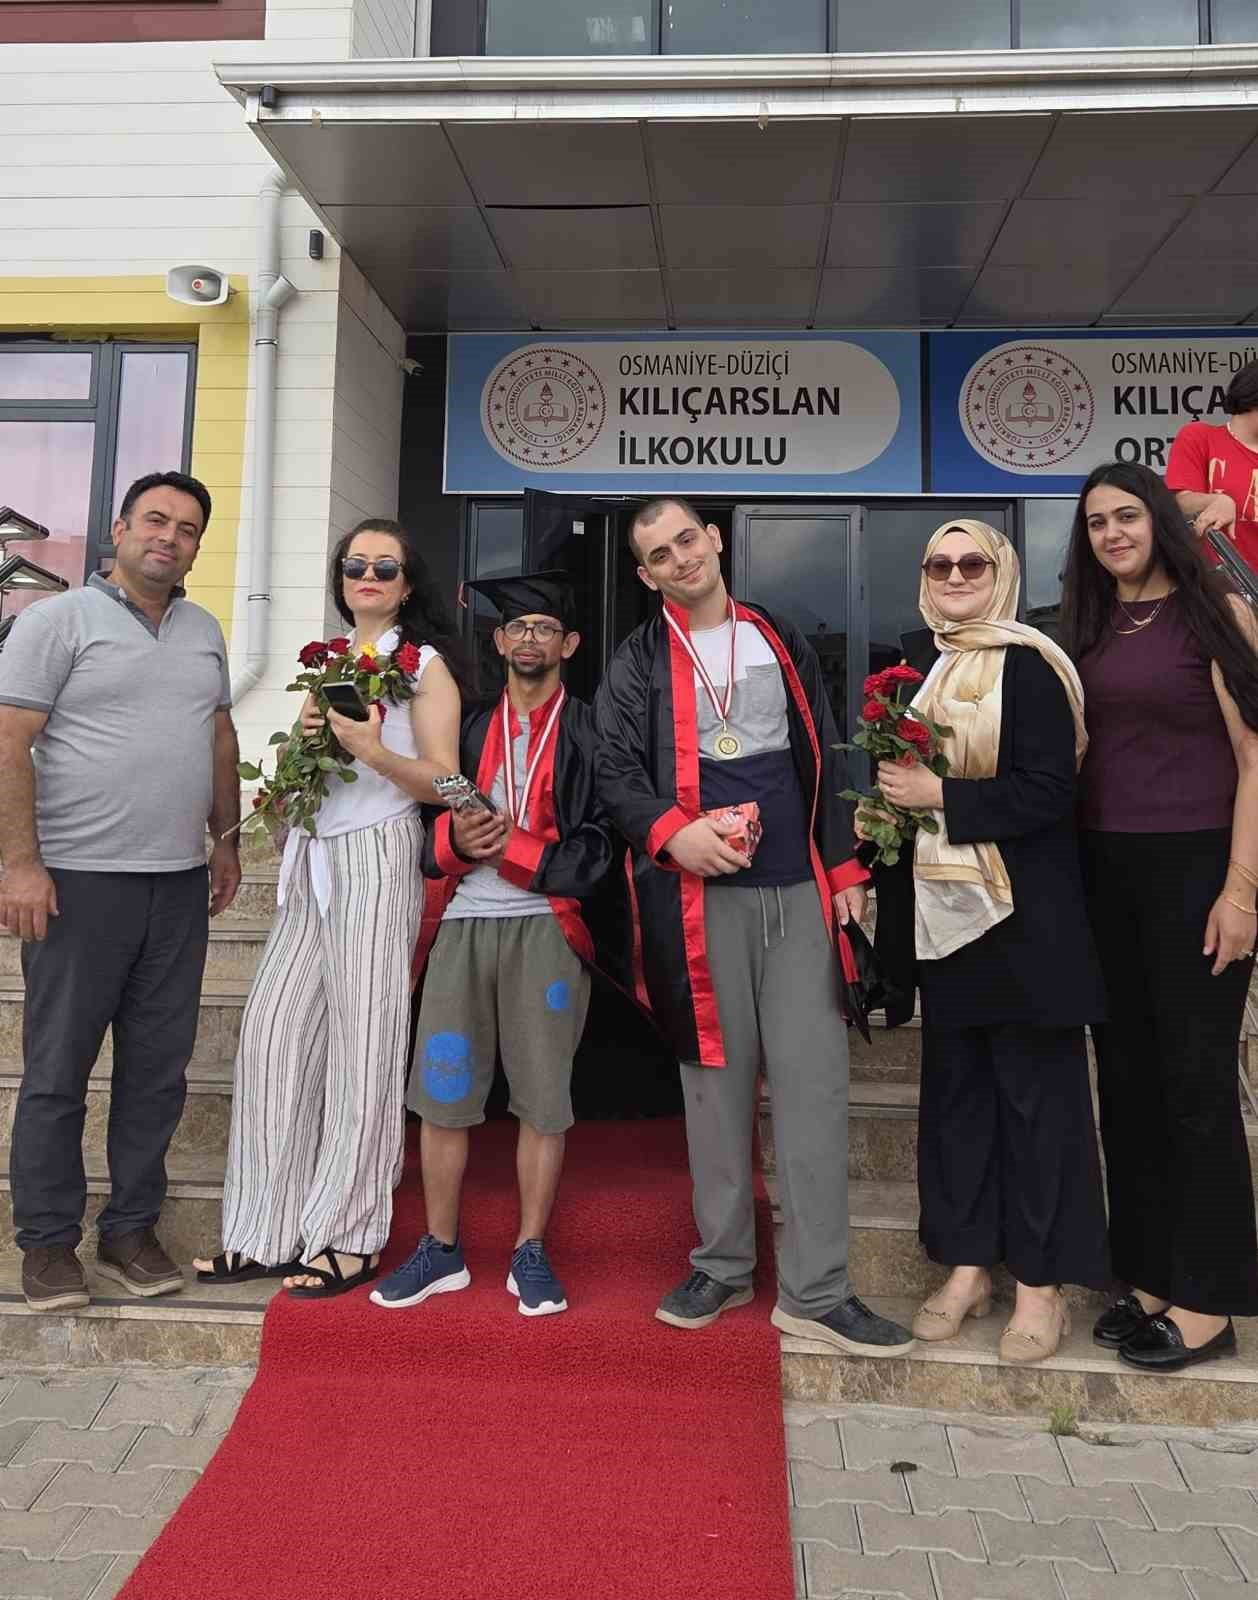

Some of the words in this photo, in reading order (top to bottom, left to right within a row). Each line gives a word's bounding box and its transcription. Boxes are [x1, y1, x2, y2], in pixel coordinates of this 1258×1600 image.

[619, 350, 789, 381] OSMANİYE-DÜZİÇİ
[620, 386, 840, 424] KILIÇARSLAN
[1114, 385, 1232, 422] KILIÇA
[619, 430, 787, 466] İLKOKULU
